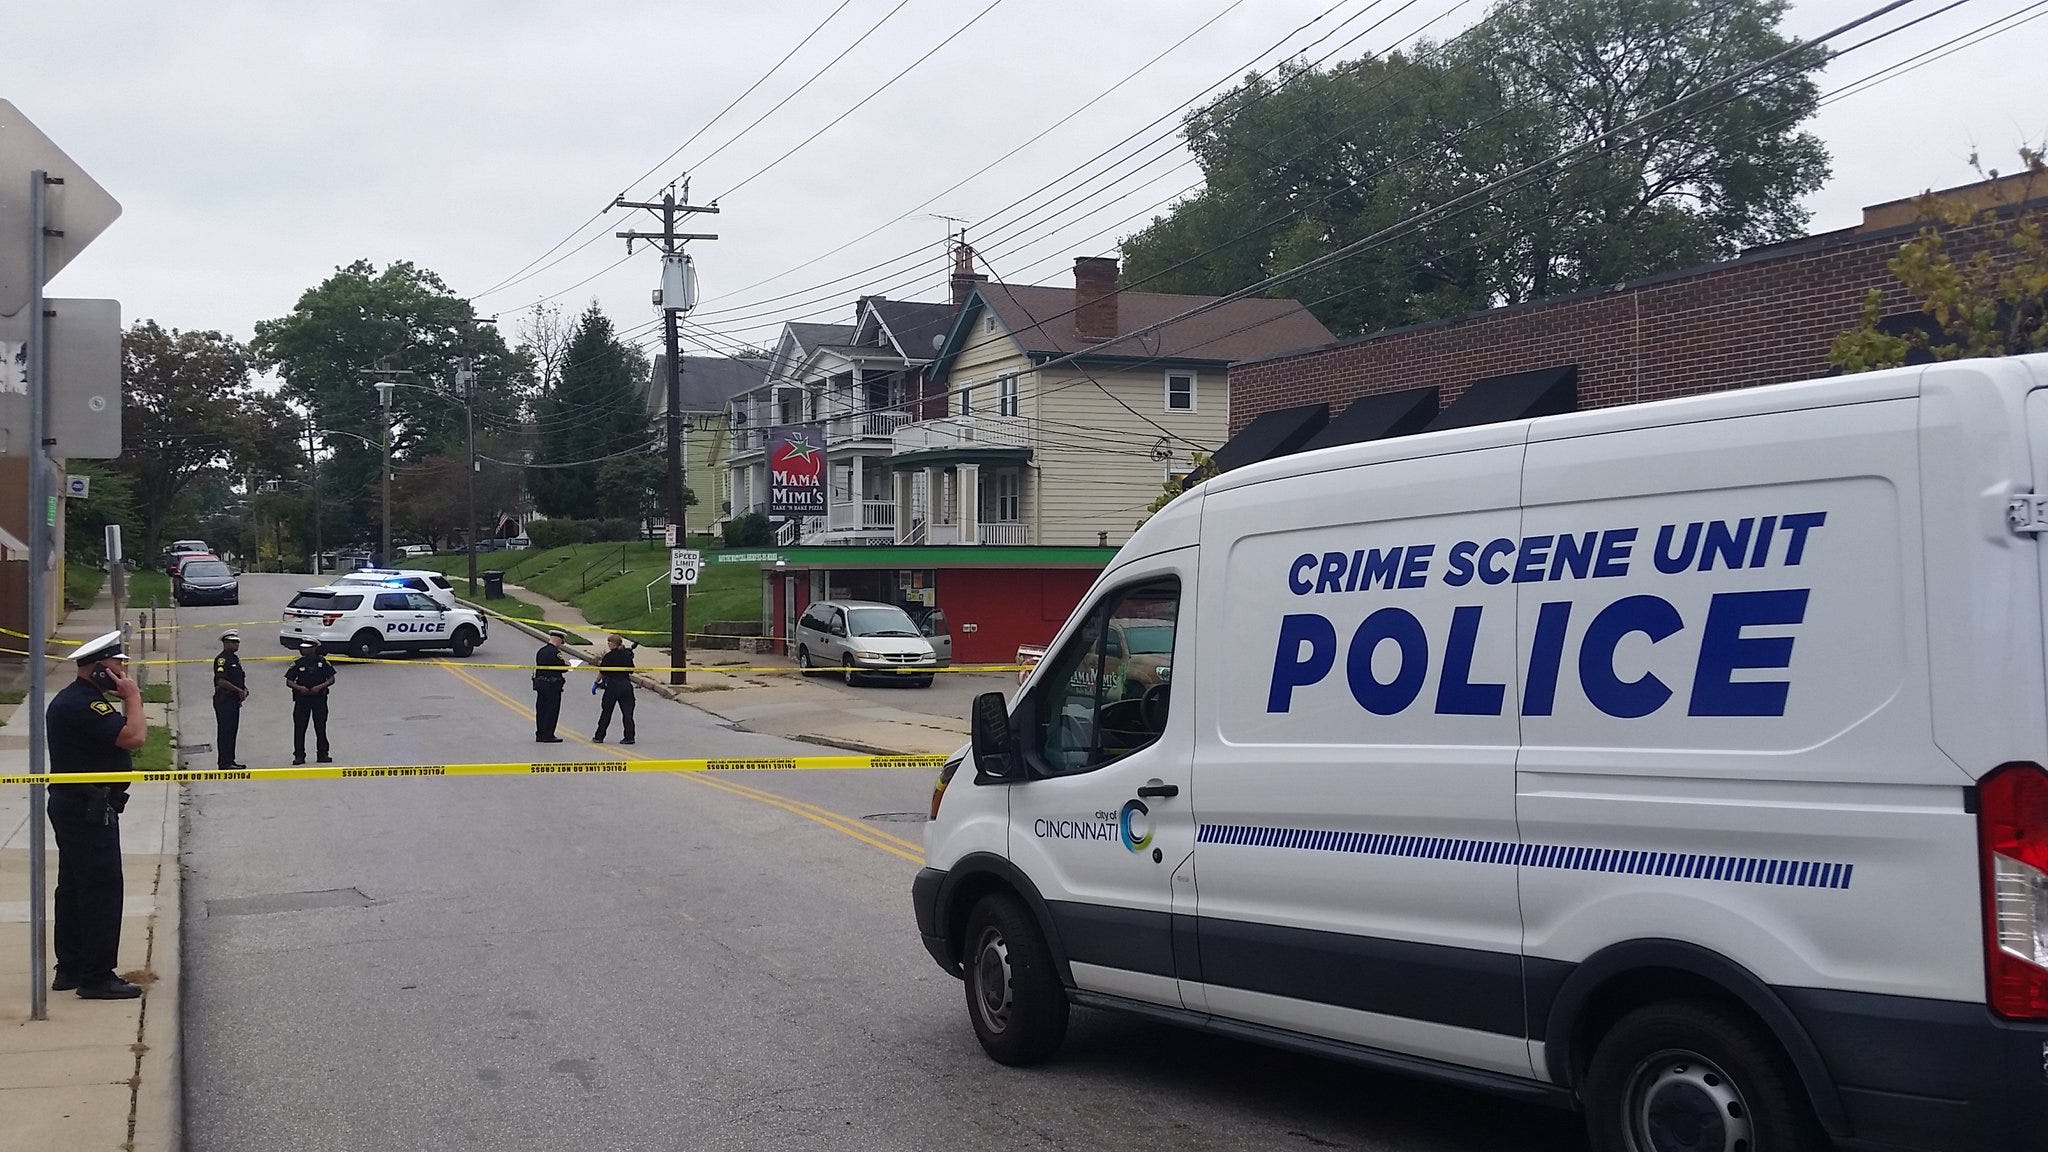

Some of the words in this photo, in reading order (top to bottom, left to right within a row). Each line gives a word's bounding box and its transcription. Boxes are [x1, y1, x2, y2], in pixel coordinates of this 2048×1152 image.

[772, 470, 820, 486] MAMA
[772, 488, 824, 504] MIMI'S
[674, 552, 697, 560] SPEED
[1287, 544, 1436, 596] CRIME
[1441, 527, 1639, 587] SCENE
[1652, 511, 1828, 575] UNIT
[673, 568, 696, 580] 30
[386, 623, 446, 633] POLICE
[1266, 588, 1811, 719] POLICE
[1090, 668, 1118, 688] MMI'S
[1095, 809, 1109, 820] city
[1110, 810, 1117, 819] of
[1034, 818, 1119, 842] CINCINNATI
